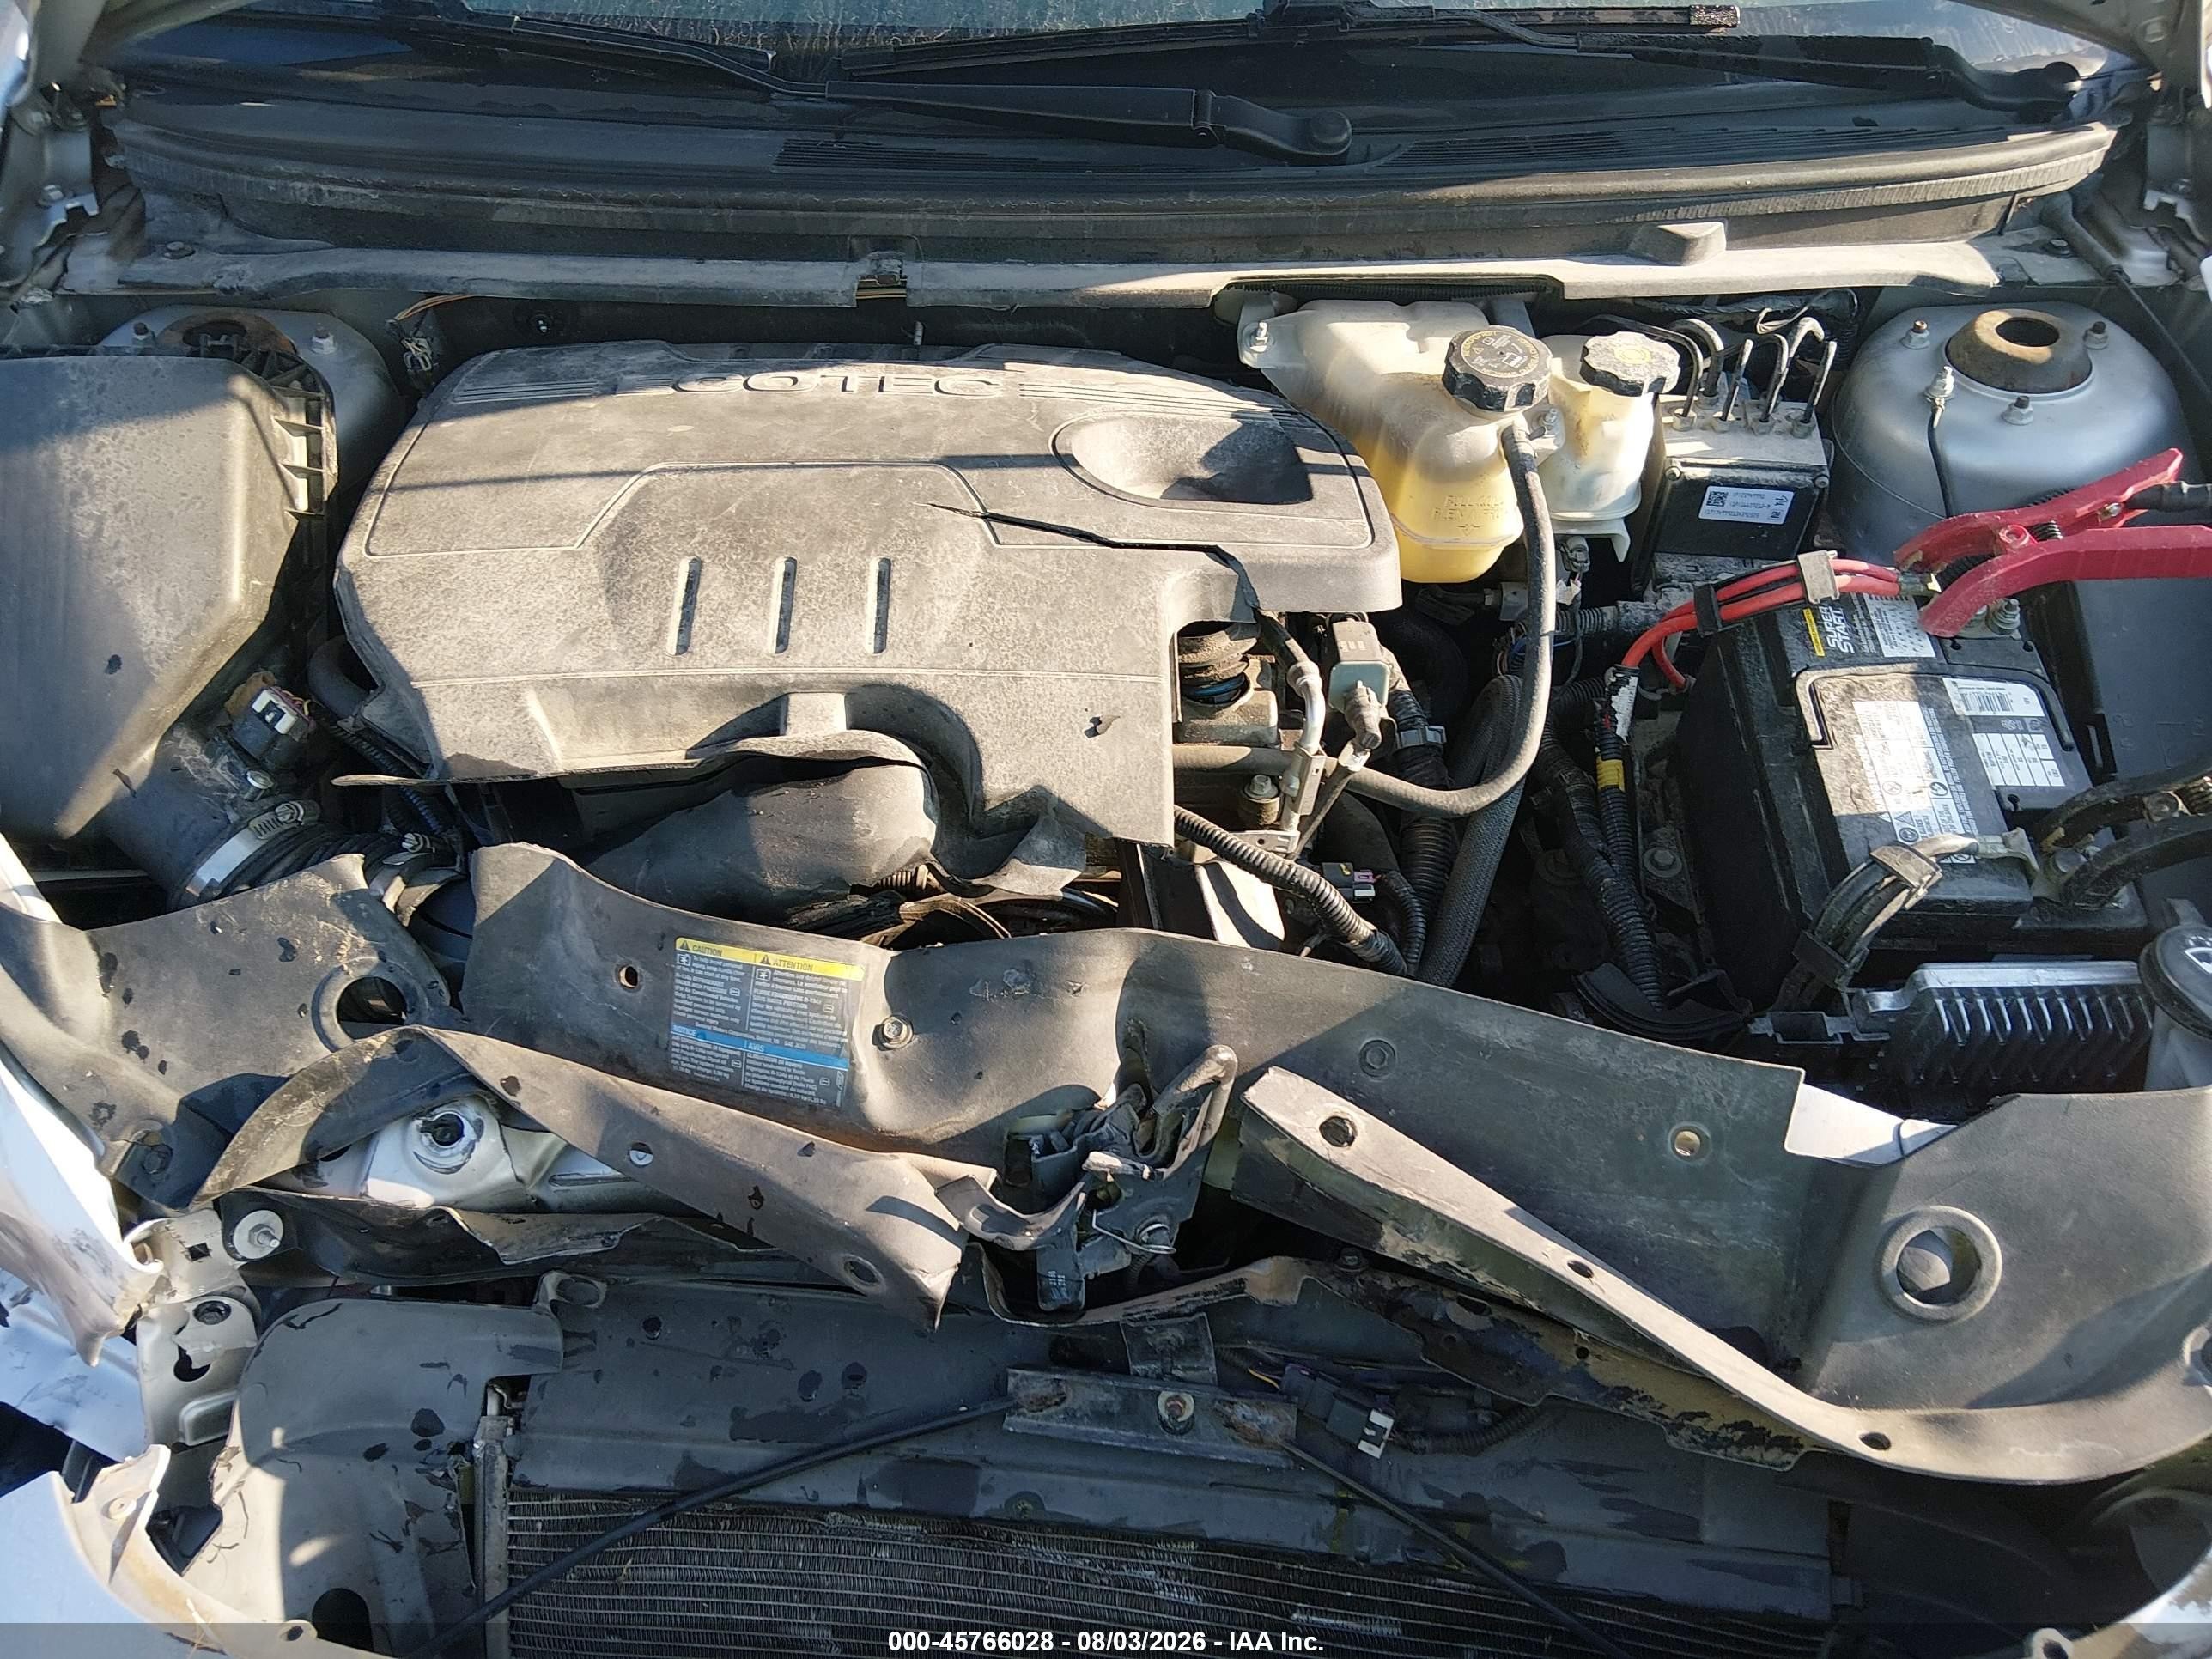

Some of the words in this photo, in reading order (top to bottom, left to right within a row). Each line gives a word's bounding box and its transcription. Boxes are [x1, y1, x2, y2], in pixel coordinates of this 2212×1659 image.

[617, 371, 1006, 399] ECOTEC
[1819, 605, 1838, 647] SUPER
[1828, 606, 1856, 654] START
[693, 945, 722, 957] CAUTION
[773, 958, 812, 971] ATTENTION
[673, 1024, 696, 1036] NOTICE
[748, 1042, 764, 1053] AVIS
